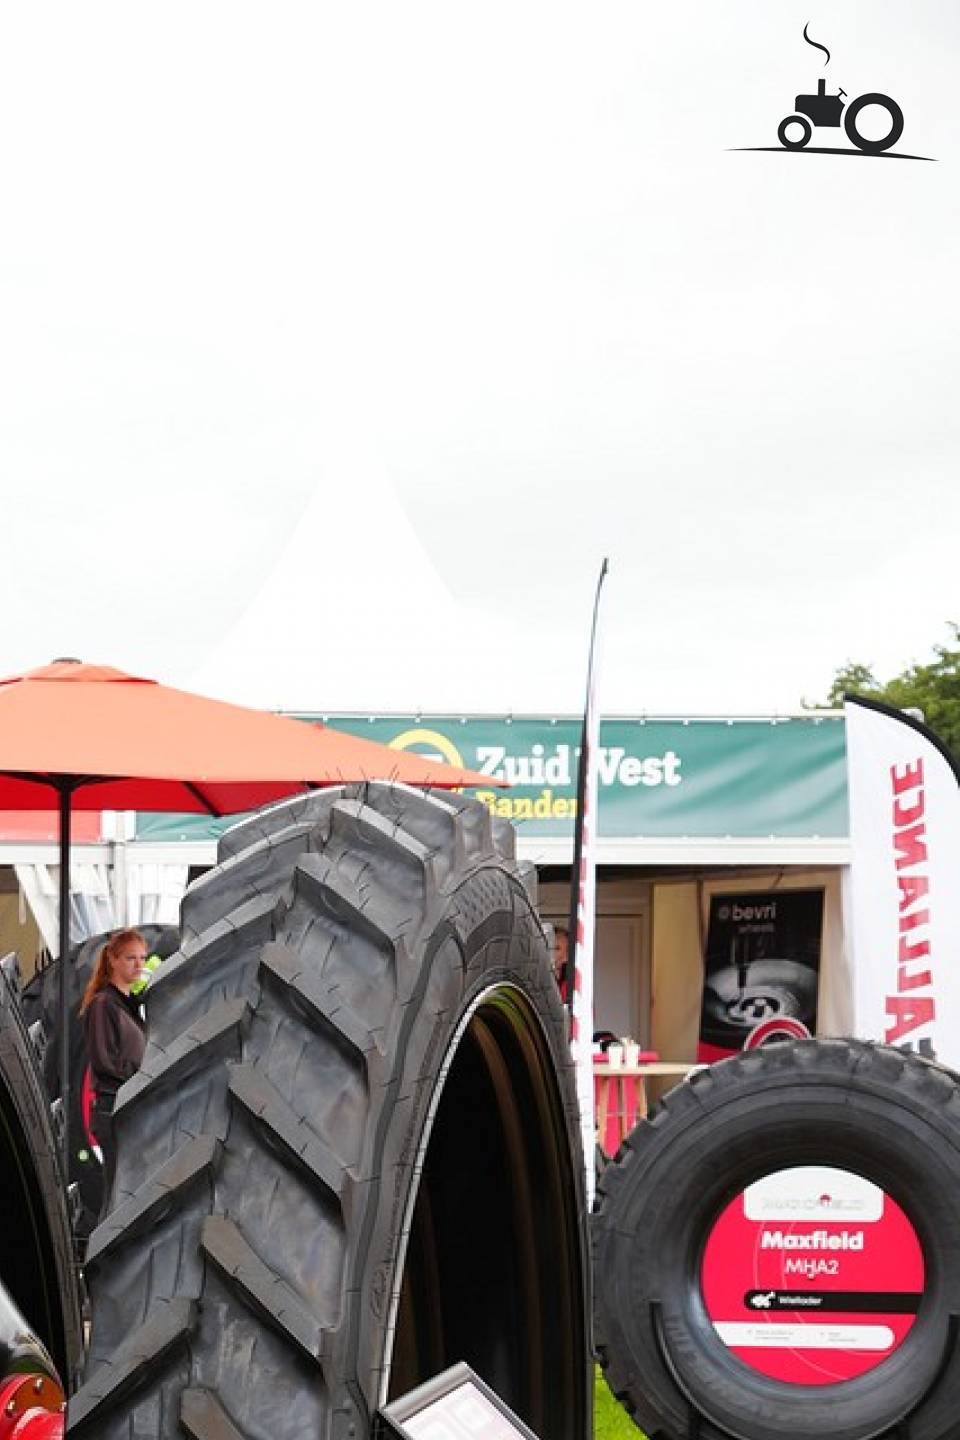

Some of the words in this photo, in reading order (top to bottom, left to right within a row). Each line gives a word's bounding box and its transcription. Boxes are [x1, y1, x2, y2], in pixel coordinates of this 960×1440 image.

[476, 744, 571, 786] Zuid
[761, 1230, 864, 1250] Maxfield
[785, 1258, 839, 1275] MHA2
